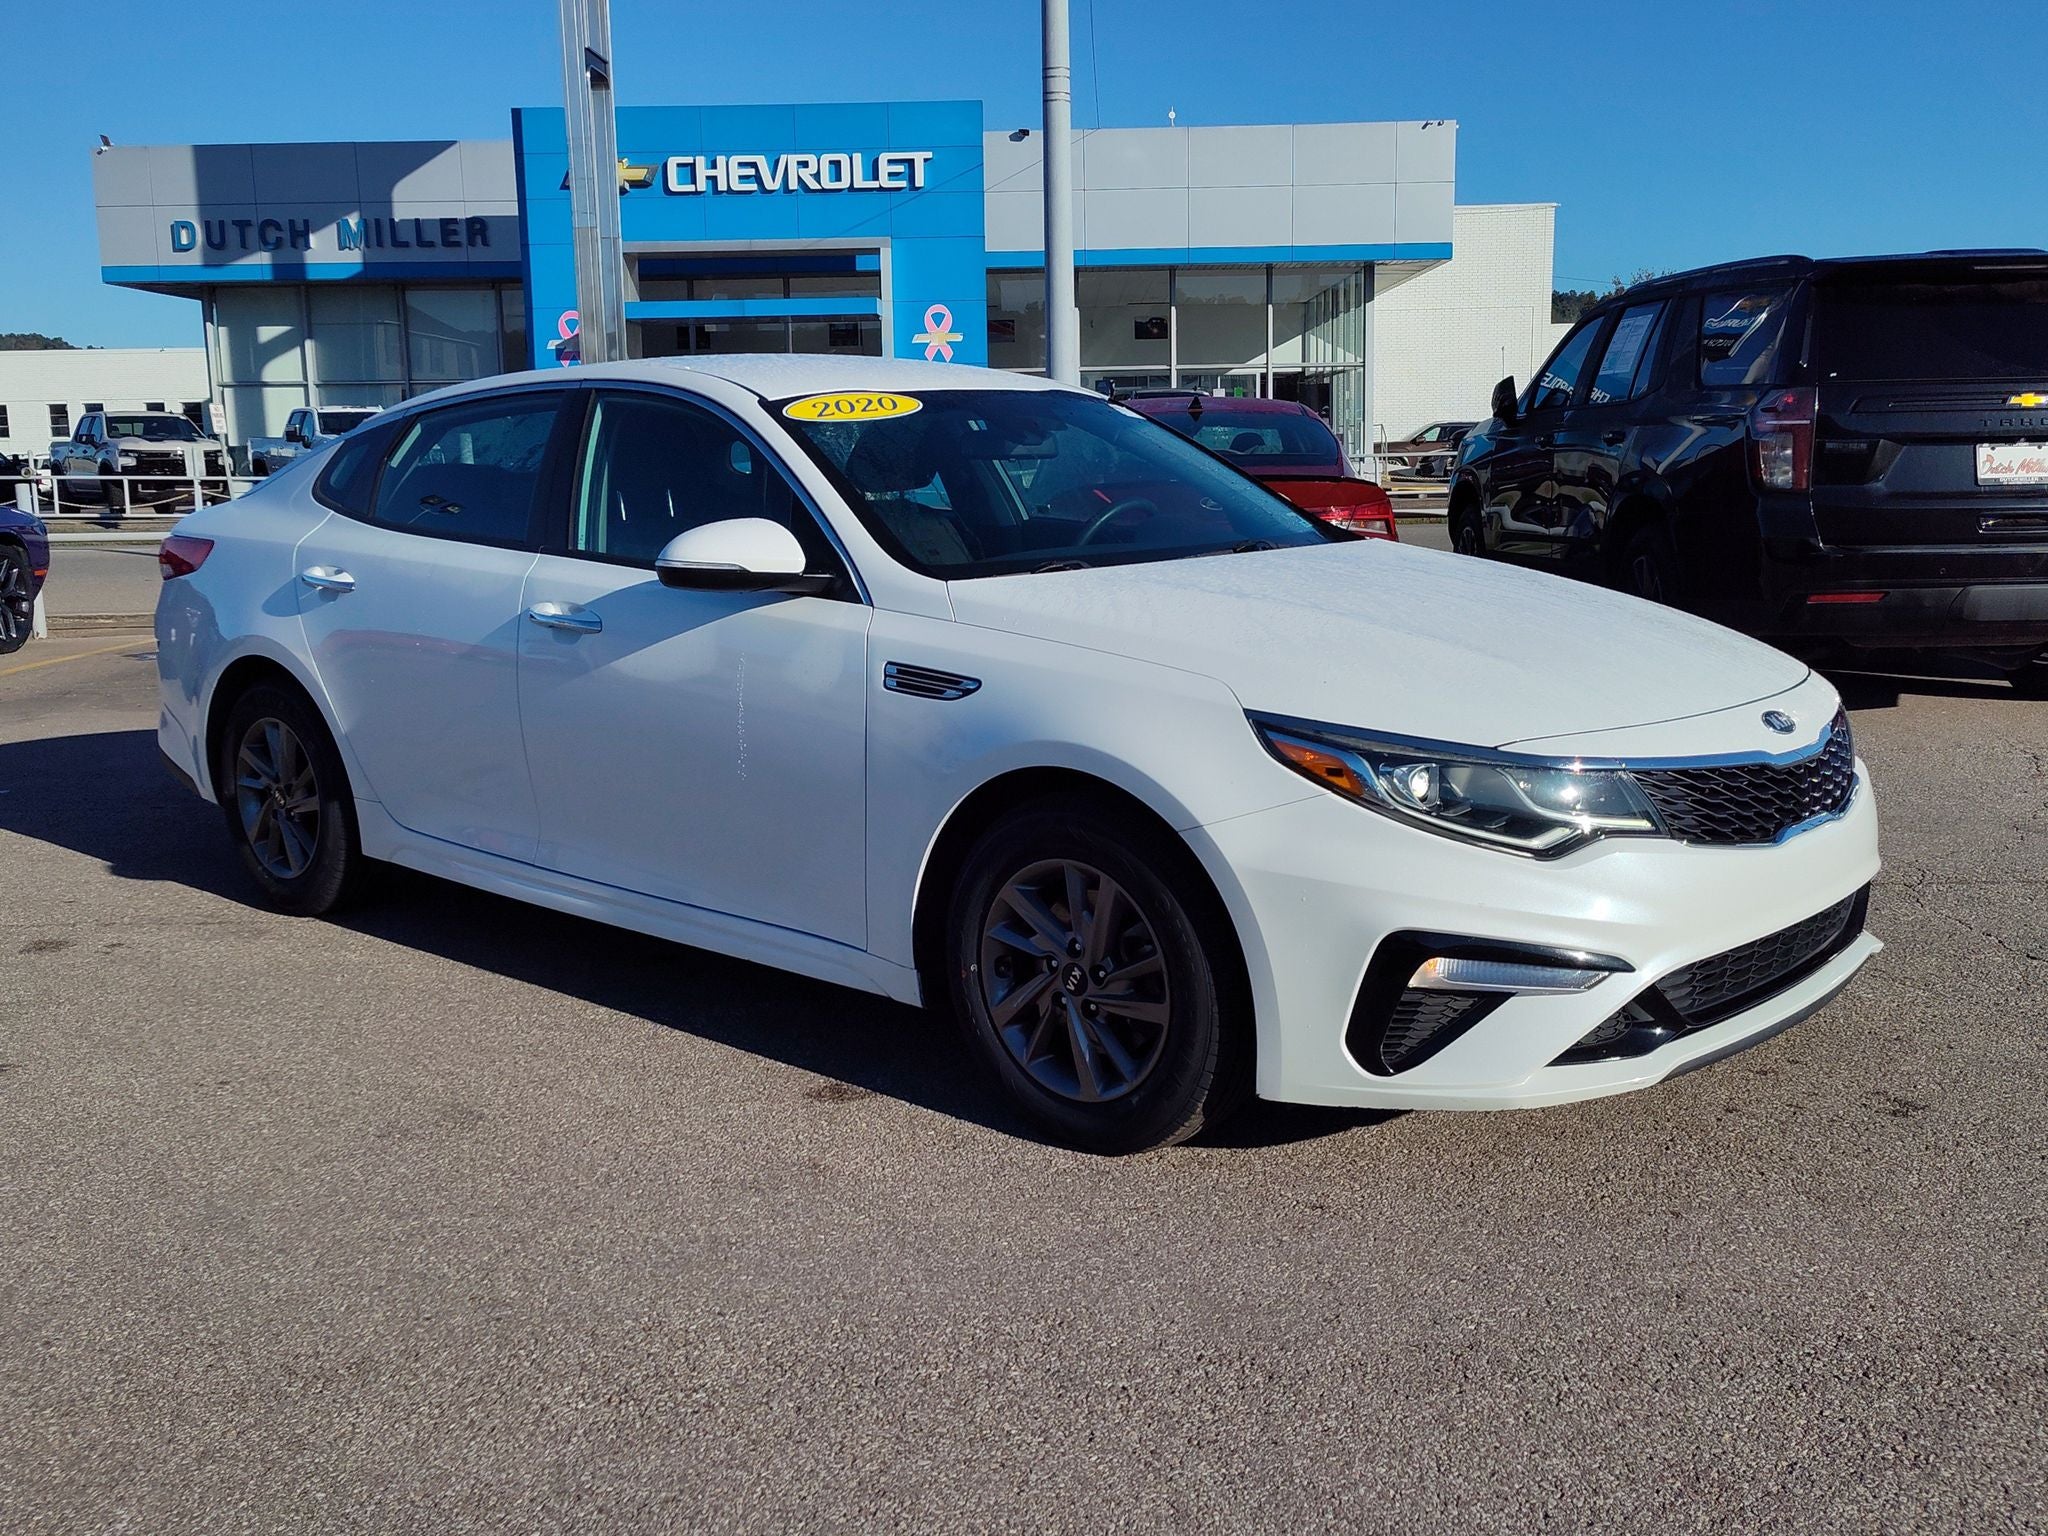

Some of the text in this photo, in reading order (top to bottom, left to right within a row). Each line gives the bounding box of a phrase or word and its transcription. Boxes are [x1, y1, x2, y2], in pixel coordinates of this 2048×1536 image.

[667, 151, 933, 192] CHEVROLET
[170, 216, 490, 253] DUTCH MILLER
[811, 396, 898, 418] 2020
[1066, 966, 1082, 991] KIA
